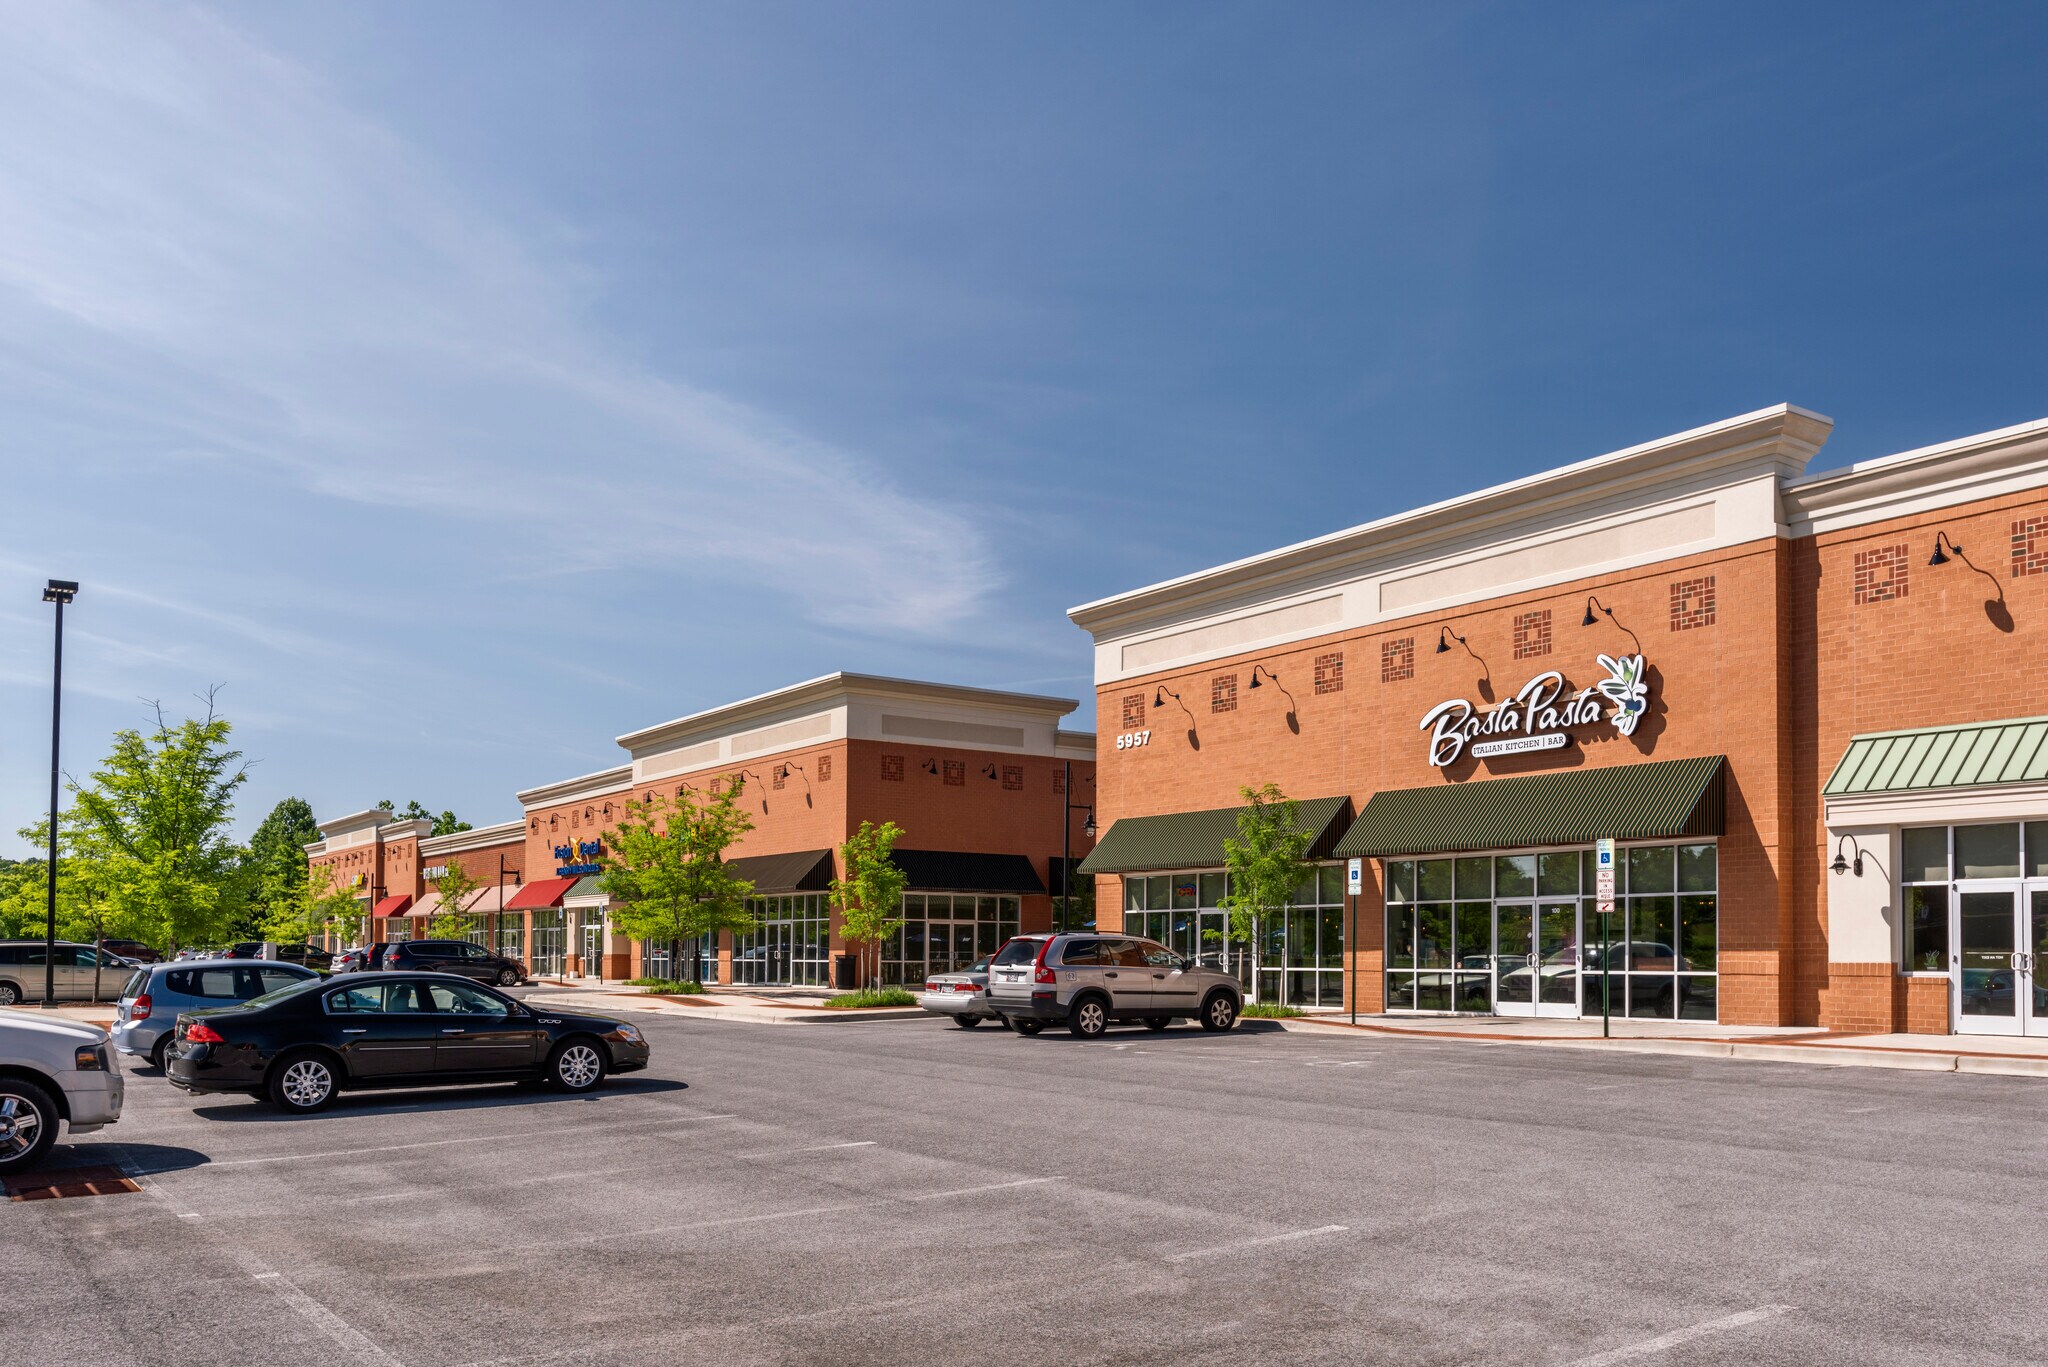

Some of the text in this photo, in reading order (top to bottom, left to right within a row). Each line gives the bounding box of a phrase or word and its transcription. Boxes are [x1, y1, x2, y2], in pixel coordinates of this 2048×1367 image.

[1419, 671, 1601, 767] Basta Pasta
[1116, 730, 1151, 750] 5957
[1473, 736, 1564, 755] ITALIAN KITCHEN BAR
[580, 838, 601, 856] Dental
